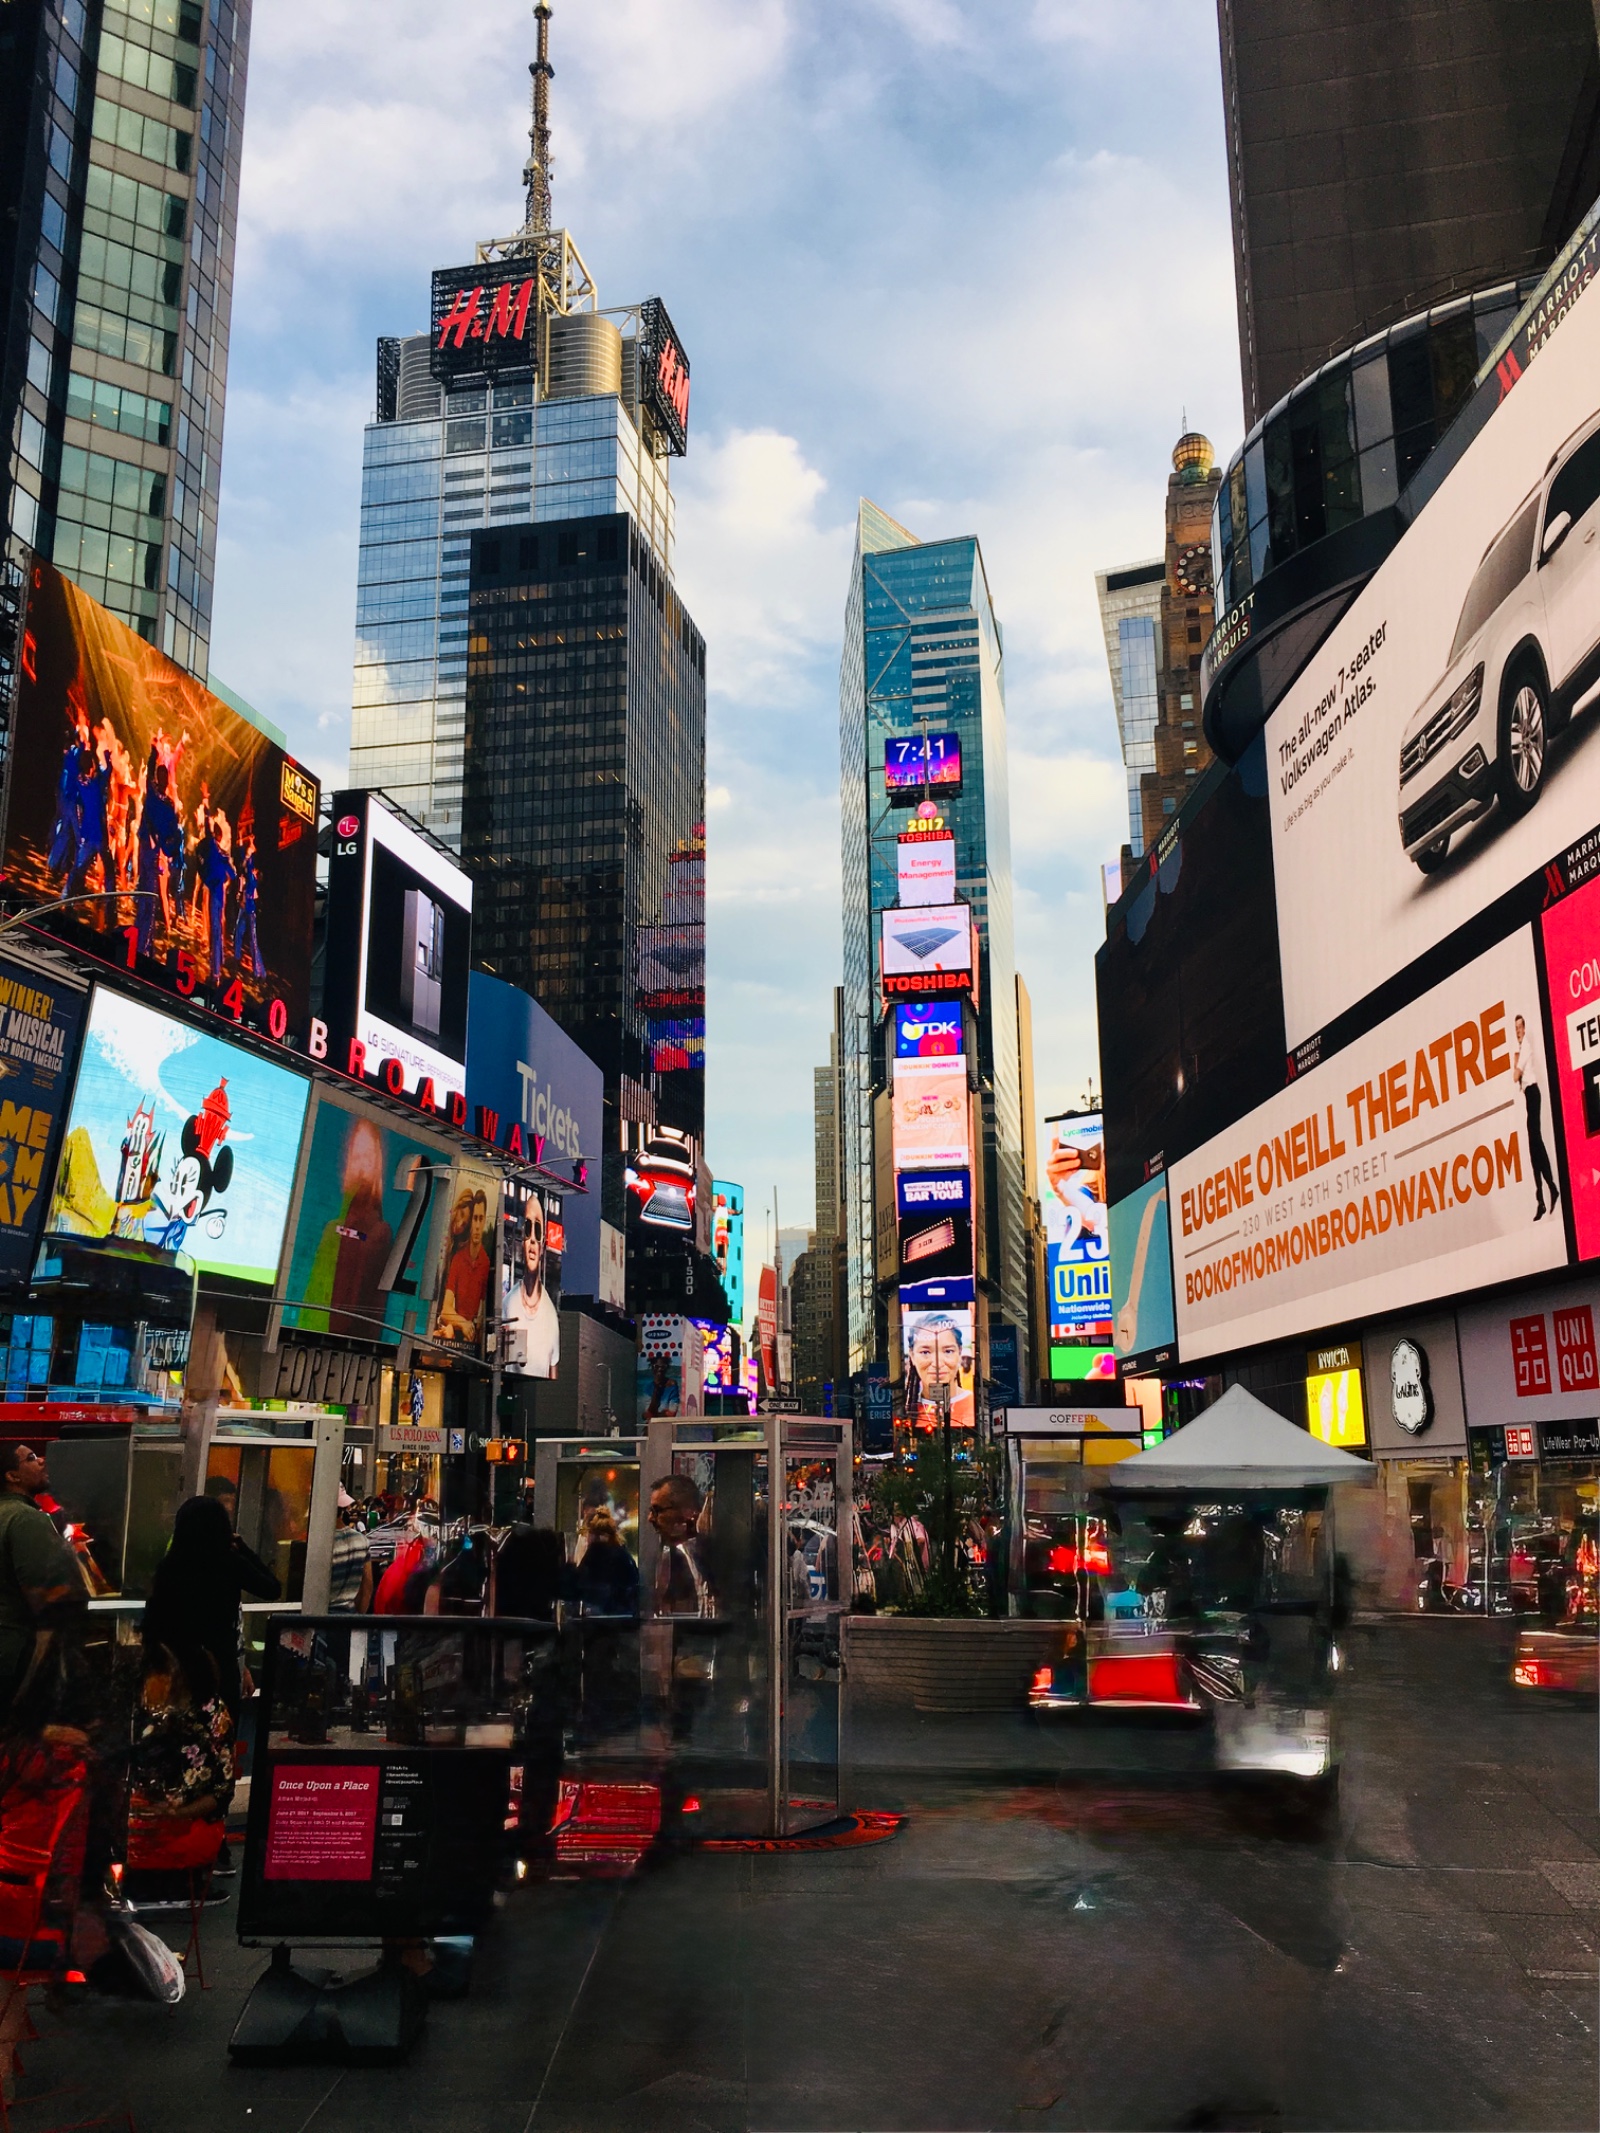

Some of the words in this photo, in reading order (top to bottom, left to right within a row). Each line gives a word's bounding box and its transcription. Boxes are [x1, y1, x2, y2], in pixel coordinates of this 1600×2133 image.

[1527, 233, 1598, 342] MARRIOTT
[437, 278, 534, 349] H&M
[659, 338, 690, 428] H&M
[1207, 592, 1255, 658] MARRIOTT
[1209, 621, 1249, 675] MARQUIS
[1278, 736, 1297, 767] The
[1299, 684, 1337, 745] all-new
[1337, 620, 1387, 695] 7-seater
[895, 739, 945, 763] 7:41
[1280, 713, 1342, 796] Volkswagen
[1343, 676, 1377, 725] Atlas.
[1319, 774, 1331, 796] you
[1331, 755, 1348, 780] make
[898, 830, 953, 843] TOSHIBA
[907, 818, 944, 832] 2017
[336, 842, 357, 856] LG
[910, 859, 942, 868] Energy
[898, 869, 954, 880] Management
[884, 972, 971, 992] TOSHIBA
[0, 975, 55, 1022] WINNER!
[6, 1009, 66, 1058] MUSICAL
[913, 1021, 957, 1036] TDK
[123, 926, 288, 1039] 1540
[309, 1016, 546, 1164] BROADWAY
[367, 1030, 379, 1048] LG
[380, 1038, 425, 1072] SIGNATURE
[1296, 1035, 1322, 1060] MARRIOTT
[33, 1050, 63, 1073] AMERICA
[1297, 1050, 1320, 1072] MARQUIS
[516, 1059, 582, 1158] Tickets
[1180, 1153, 1254, 1237] EUGENE
[1256, 1104, 1346, 1197] O'NEILL
[1346, 1001, 1512, 1148] THEATRE
[905, 1191, 930, 1202] BAR
[931, 1189, 963, 1200] TOUR
[936, 1180, 963, 1190] DIVE
[1242, 1217, 1260, 1238] 230
[1265, 1198, 1295, 1227] WEST
[1299, 1183, 1330, 1211] 49TH
[1336, 1151, 1389, 1194] STREET
[1186, 1131, 1523, 1305] BOOKOFMORMONBROADWAY.COM
[685, 1256, 694, 1295] 1500
[1058, 1266, 1109, 1298] Unli
[1058, 1301, 1110, 1314] Nationwide
[1558, 1316, 1588, 1347] UNI
[1317, 1347, 1350, 1370] INVICTA
[1562, 1351, 1594, 1386] QLO
[273, 1344, 380, 1405] FOREVER
[1049, 1413, 1098, 1424] COFFEED
[390, 1427, 403, 1441] U.S.
[404, 1428, 422, 1442] POLO
[423, 1429, 441, 1443] ASSN.
[1542, 1436, 1571, 1450] LifeWear
[1573, 1434, 1600, 1451] Pop-Up
[279, 1780, 304, 1790] Once
[306, 1781, 332, 1791] Upon
[342, 1781, 370, 1791] Place
